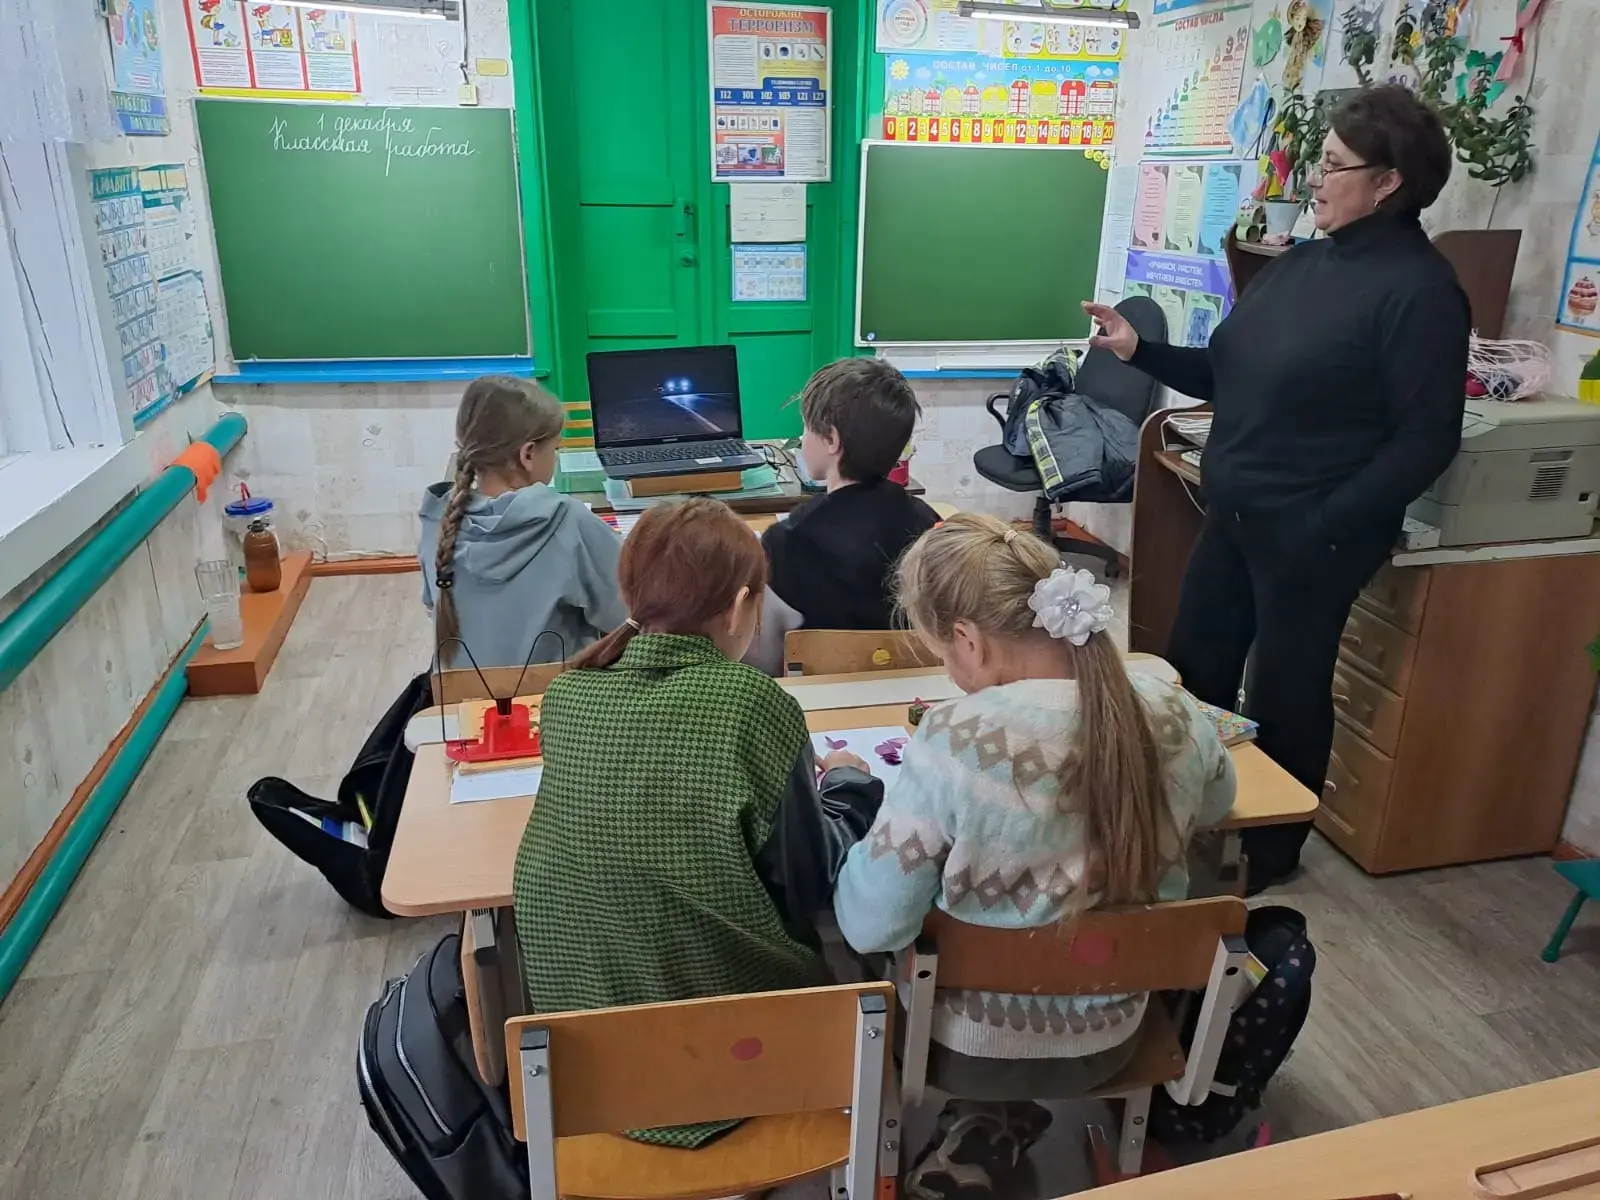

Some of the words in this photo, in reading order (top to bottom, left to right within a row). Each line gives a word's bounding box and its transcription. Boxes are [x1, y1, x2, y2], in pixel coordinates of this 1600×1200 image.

[729, 19, 814, 33] ТЕРРОРИЗМ
[1226, 36, 1234, 54] 9
[1237, 25, 1247, 41] 10
[720, 91, 732, 99] 112
[742, 91, 754, 99] 101
[269, 116, 372, 153] Классная
[317, 113, 325, 131] 1
[334, 108, 415, 149] декабря
[888, 121, 895, 135] 0
[909, 121, 916, 136] 2
[930, 122, 938, 136] 4
[942, 122, 948, 136] 5
[952, 122, 959, 137] 6
[963, 122, 969, 137] 7
[974, 122, 981, 137] 8
[984, 123, 990, 137] 9
[994, 123, 1003, 137] 10
[1007, 124, 1014, 137] 11
[1016, 124, 1026, 138] 12
[1039, 124, 1048, 138] 14
[1050, 124, 1057, 138] 15
[1060, 124, 1070, 138] 16
[1083, 125, 1092, 138] 18
[1104, 126, 1113, 138] 20
